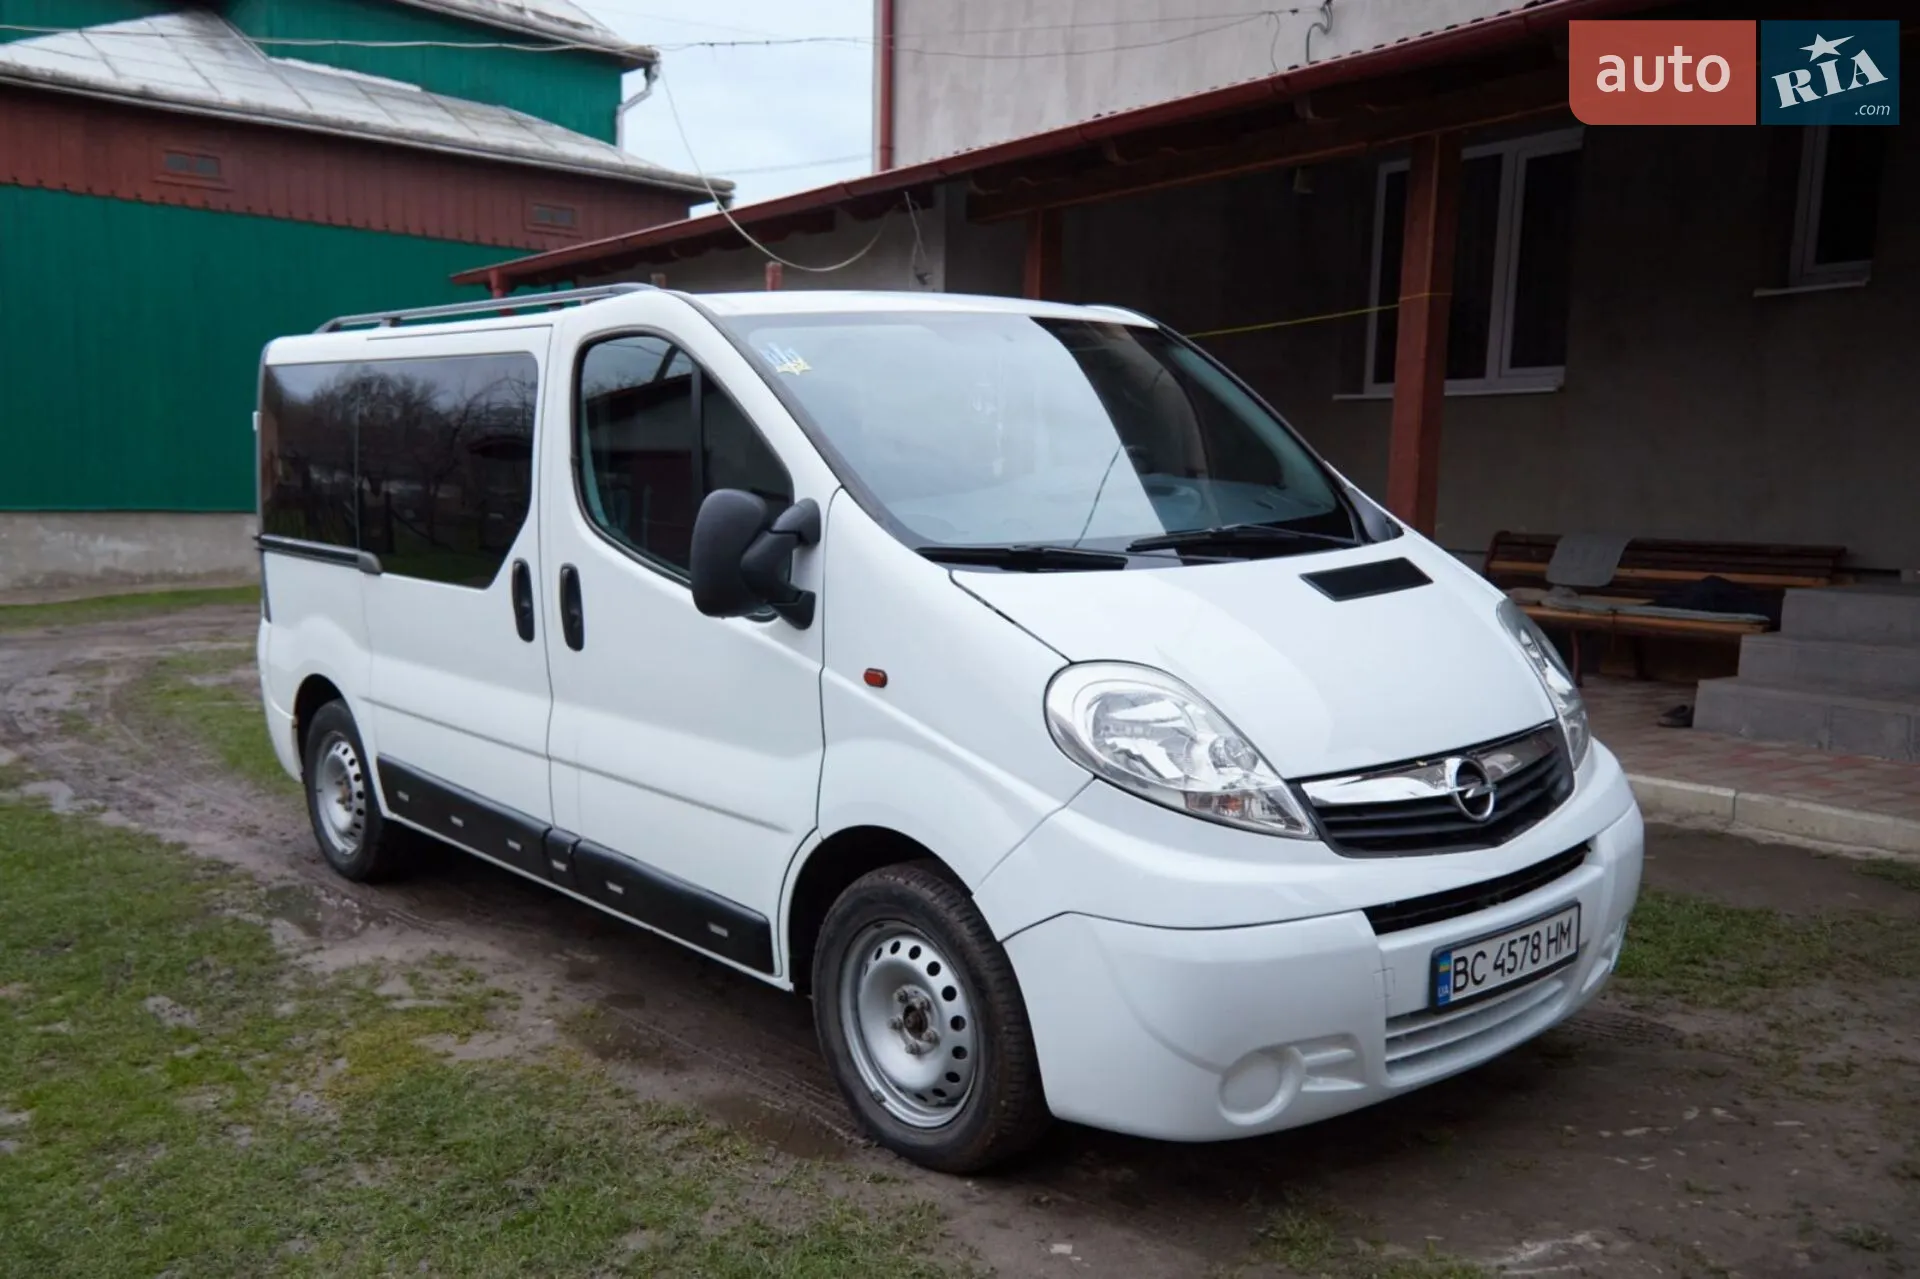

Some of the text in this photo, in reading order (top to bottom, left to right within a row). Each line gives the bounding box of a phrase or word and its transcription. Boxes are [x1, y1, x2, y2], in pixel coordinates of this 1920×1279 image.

[1453, 917, 1572, 994] BC 4578 HM
